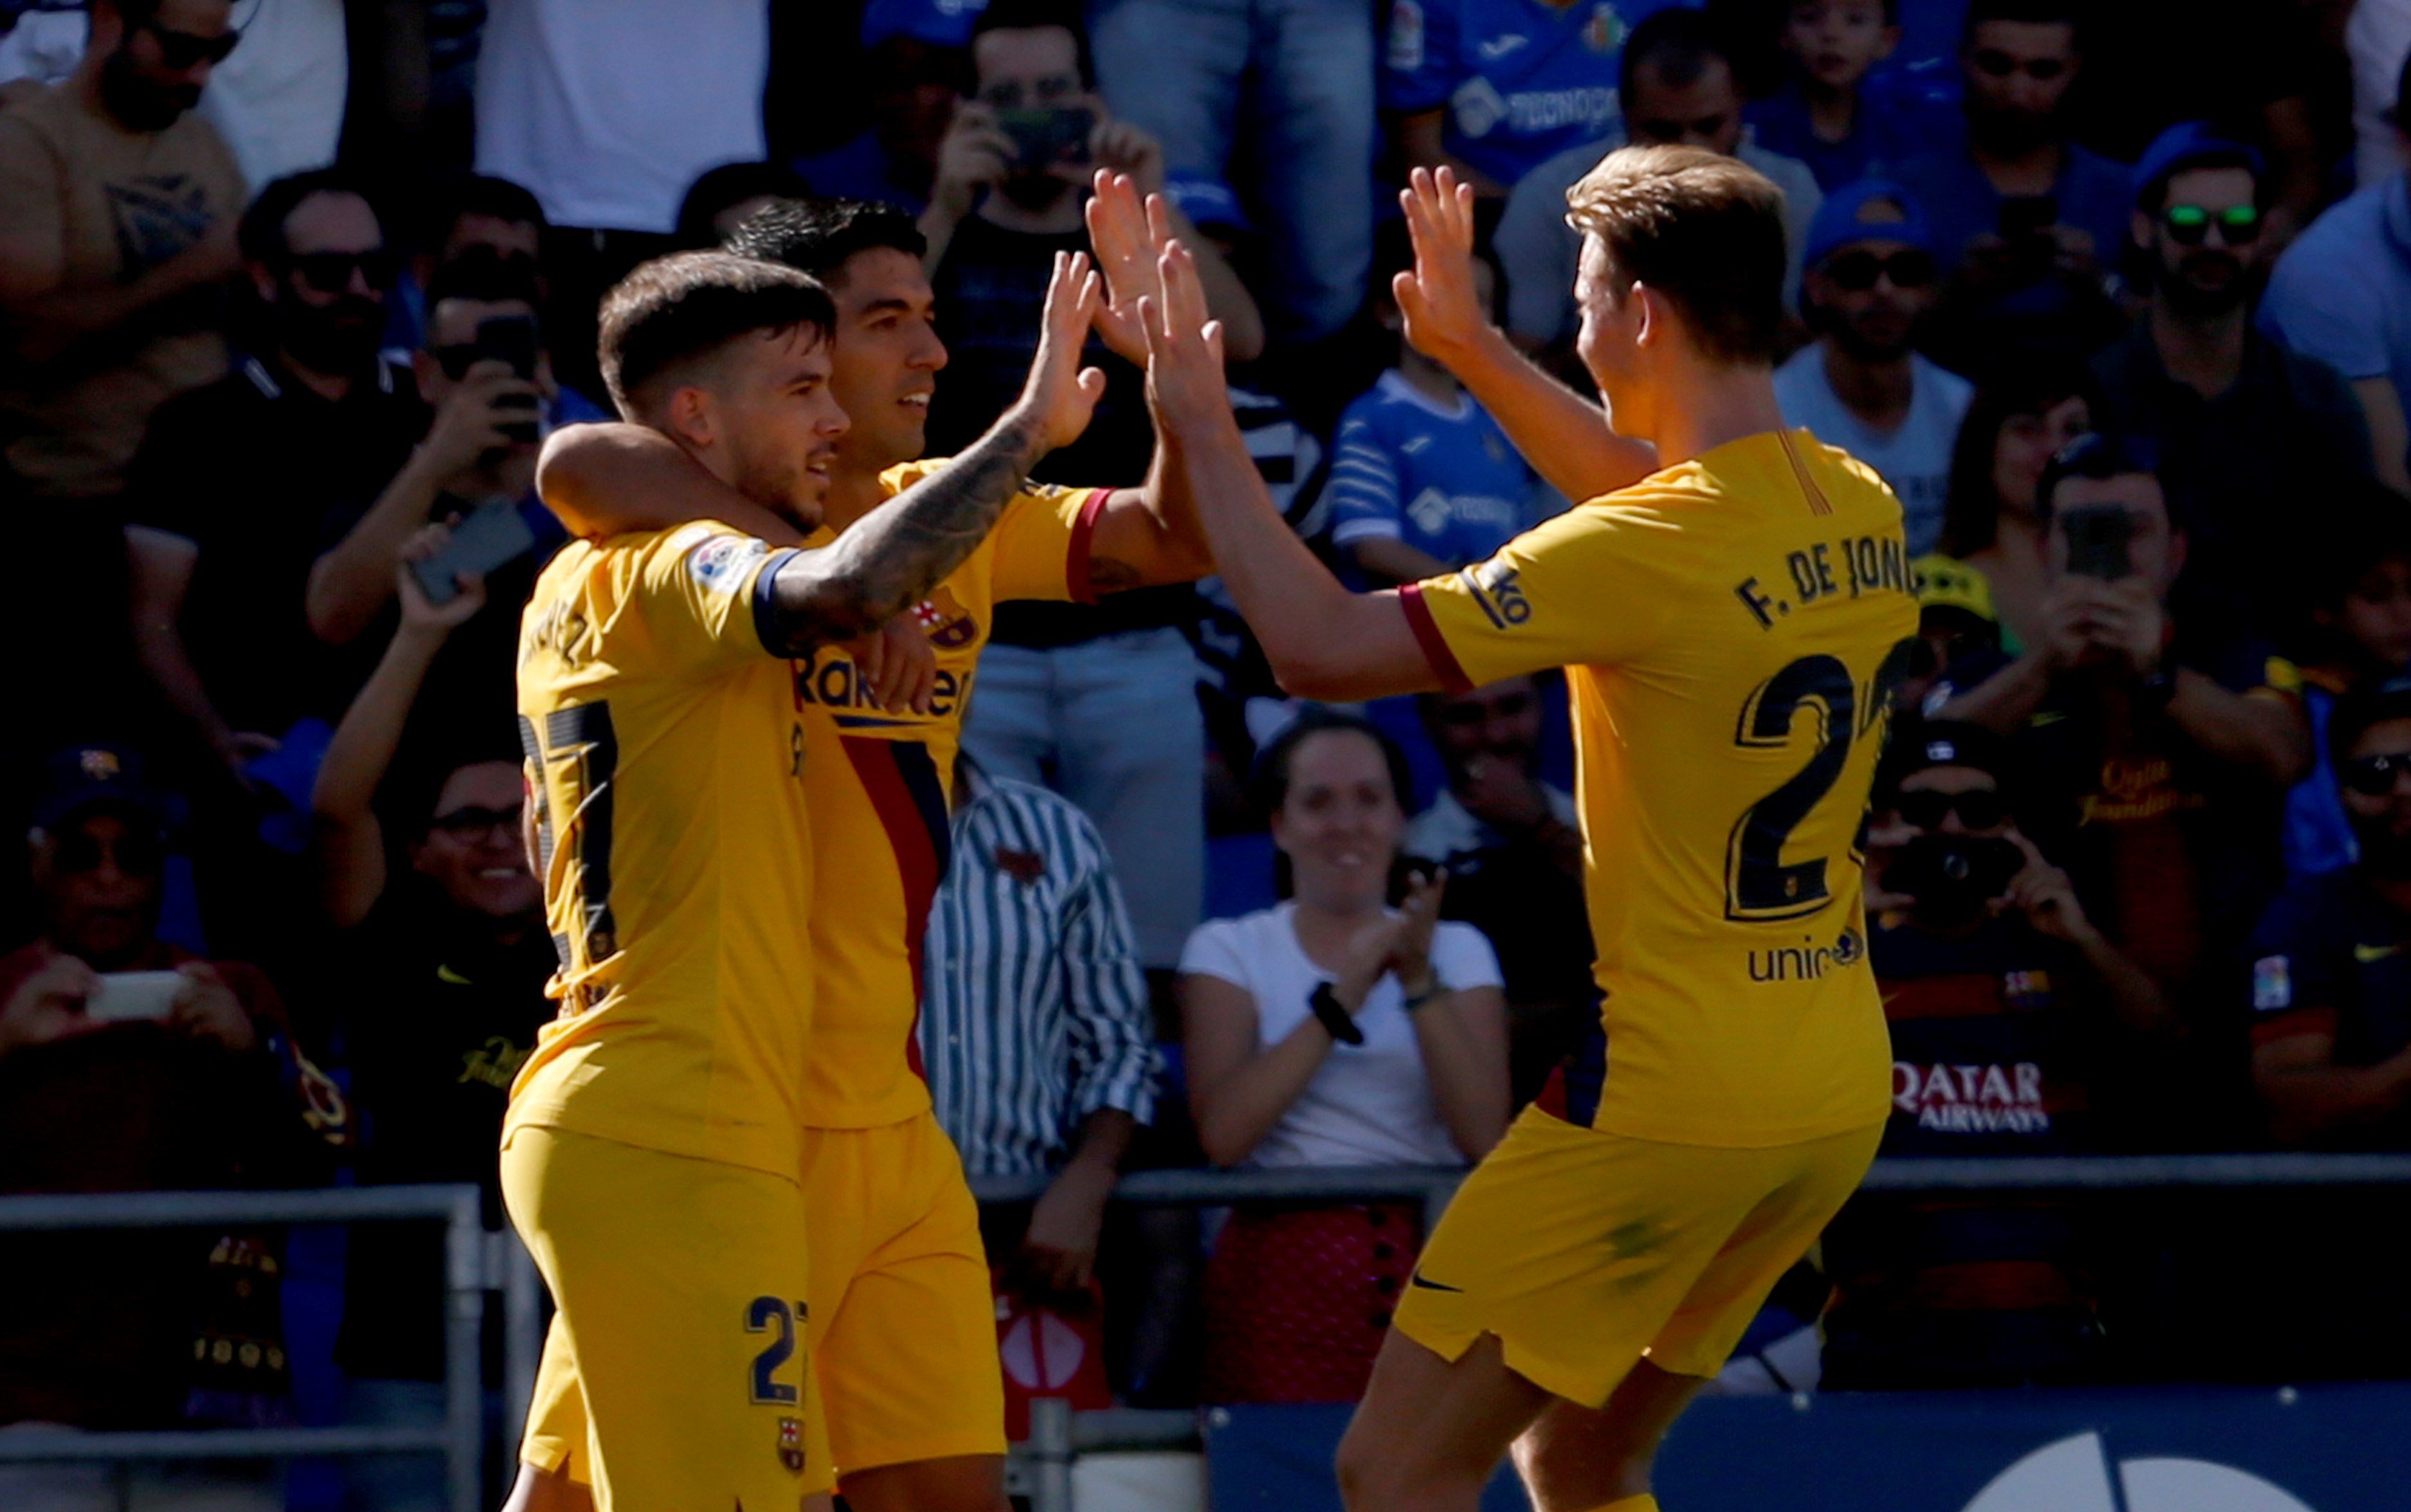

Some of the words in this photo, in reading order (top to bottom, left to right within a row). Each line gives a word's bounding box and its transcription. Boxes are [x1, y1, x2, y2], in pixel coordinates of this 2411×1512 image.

[1734, 576, 1790, 631] F.
[1785, 543, 1838, 604] DE
[1893, 1061, 2043, 1113] QATAR
[1918, 1102, 2050, 1133] AIRWAYS
[745, 1295, 808, 1407] 2
